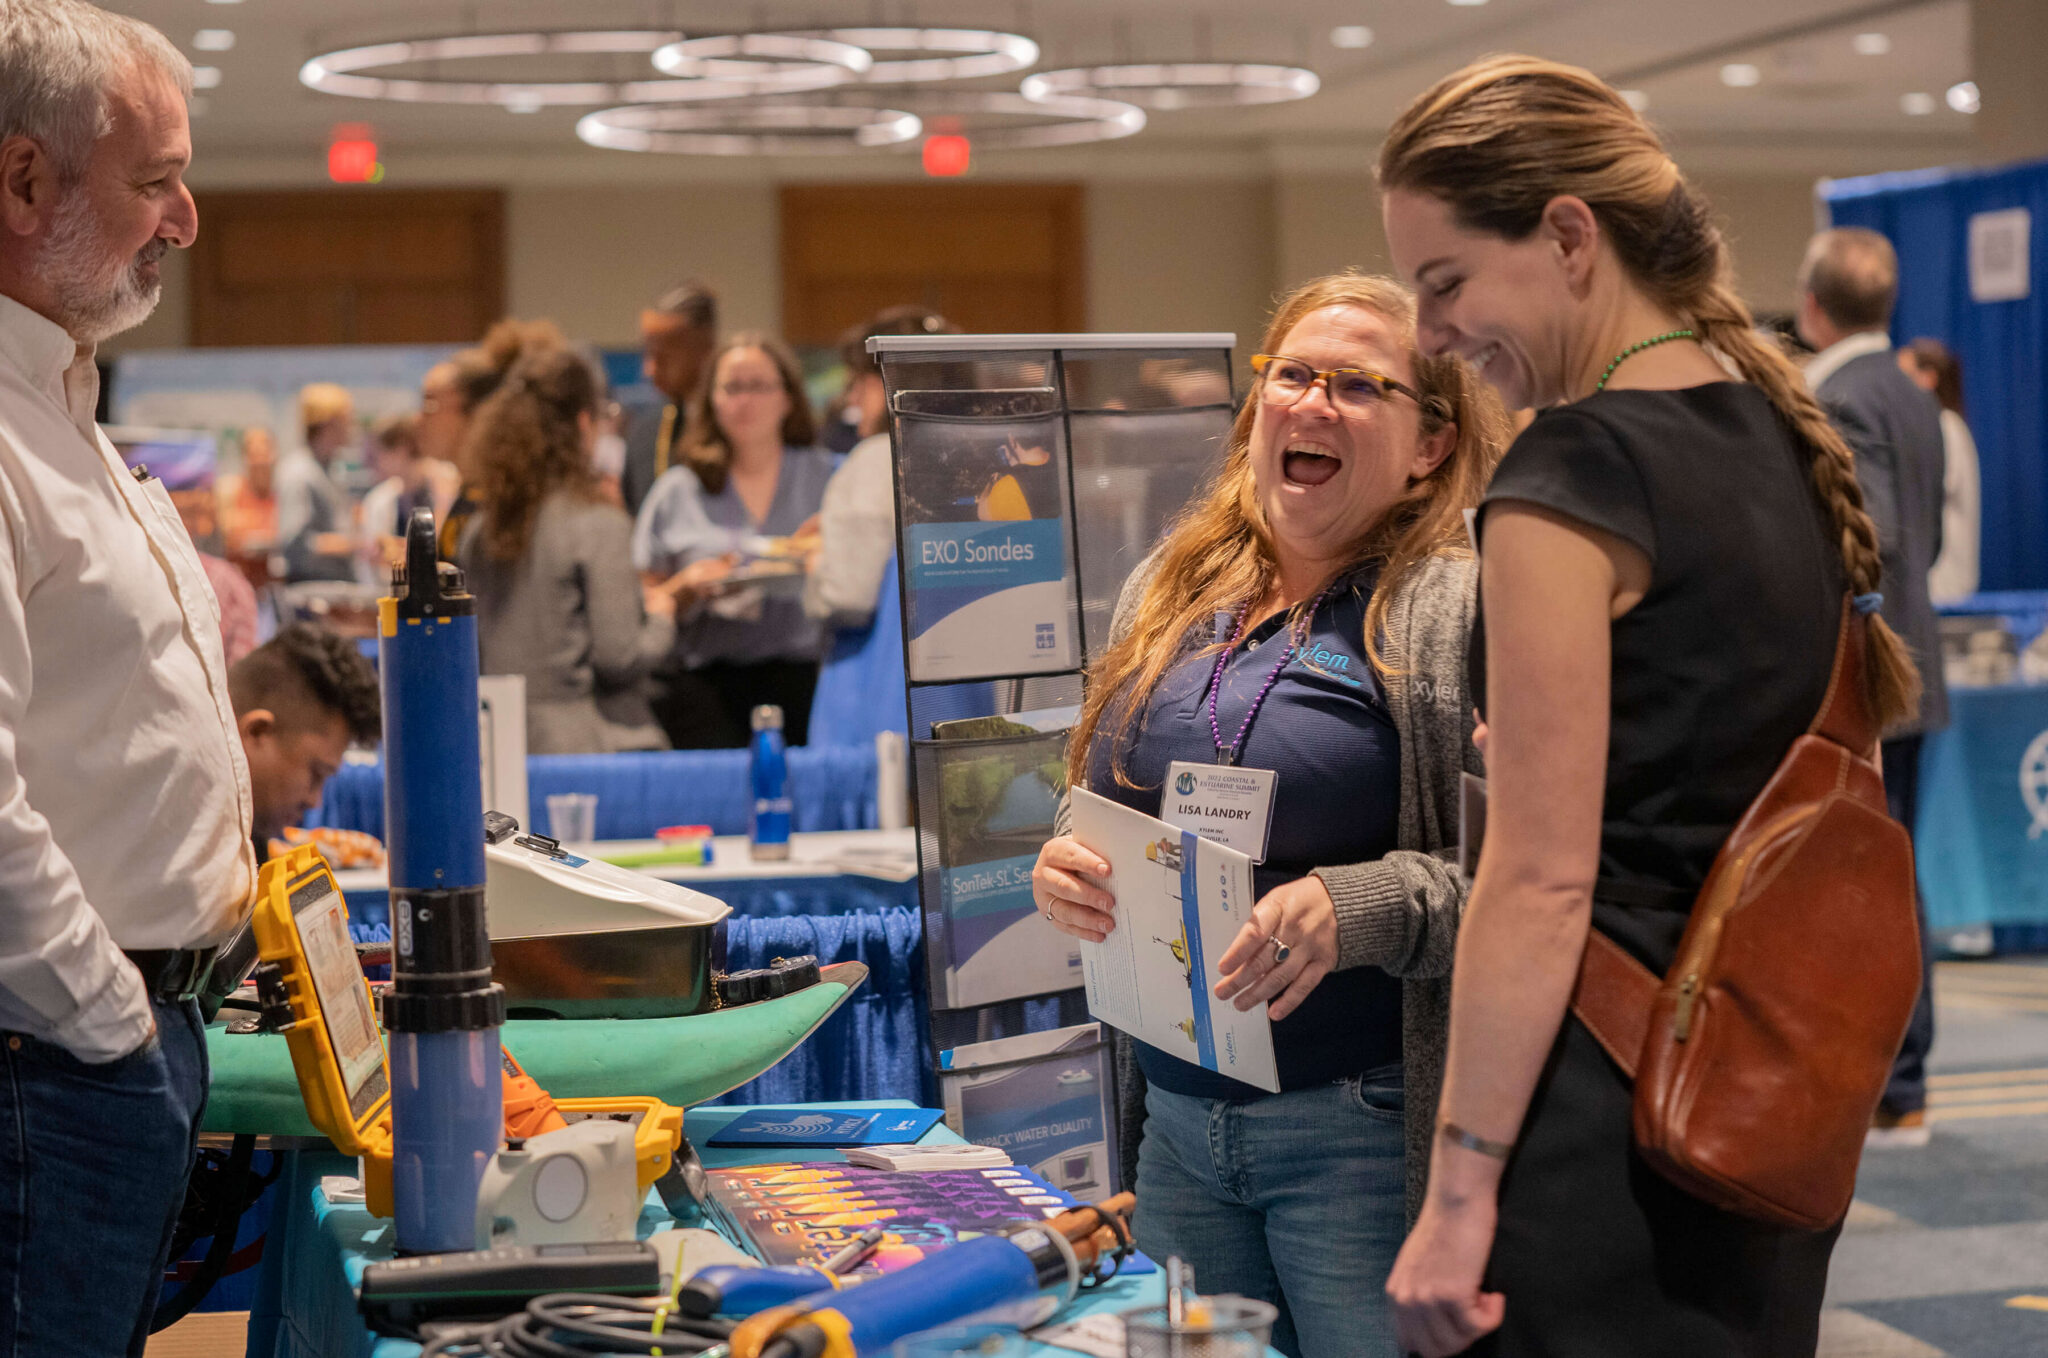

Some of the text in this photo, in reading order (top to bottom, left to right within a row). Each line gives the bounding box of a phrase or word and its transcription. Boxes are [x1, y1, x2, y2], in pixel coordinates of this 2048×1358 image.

[922, 536, 1034, 564] EXO Sondes
[1178, 804, 1252, 820] LISA LANDRY
[1014, 1126, 1048, 1143] WATER
[1050, 1118, 1093, 1136] QUALITY
